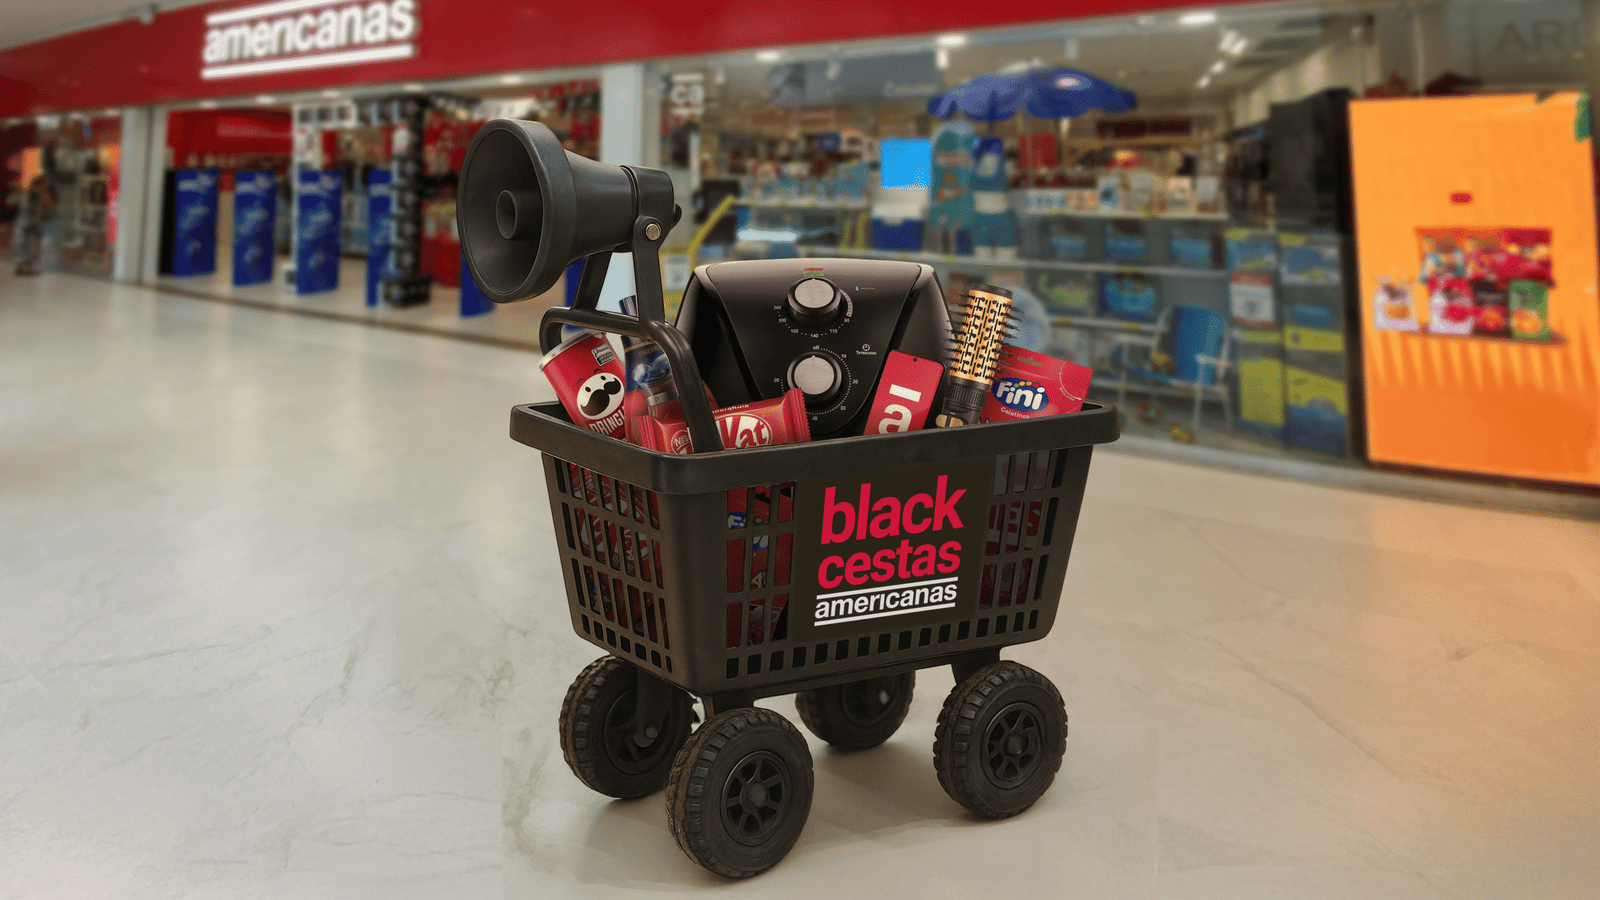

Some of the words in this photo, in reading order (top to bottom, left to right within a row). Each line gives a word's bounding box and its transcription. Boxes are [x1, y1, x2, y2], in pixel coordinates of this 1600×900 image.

[204, 0, 415, 62] americanas
[996, 381, 1046, 410] Fini
[820, 474, 967, 545] black
[817, 539, 962, 589] cestas
[814, 583, 957, 619] americanas
